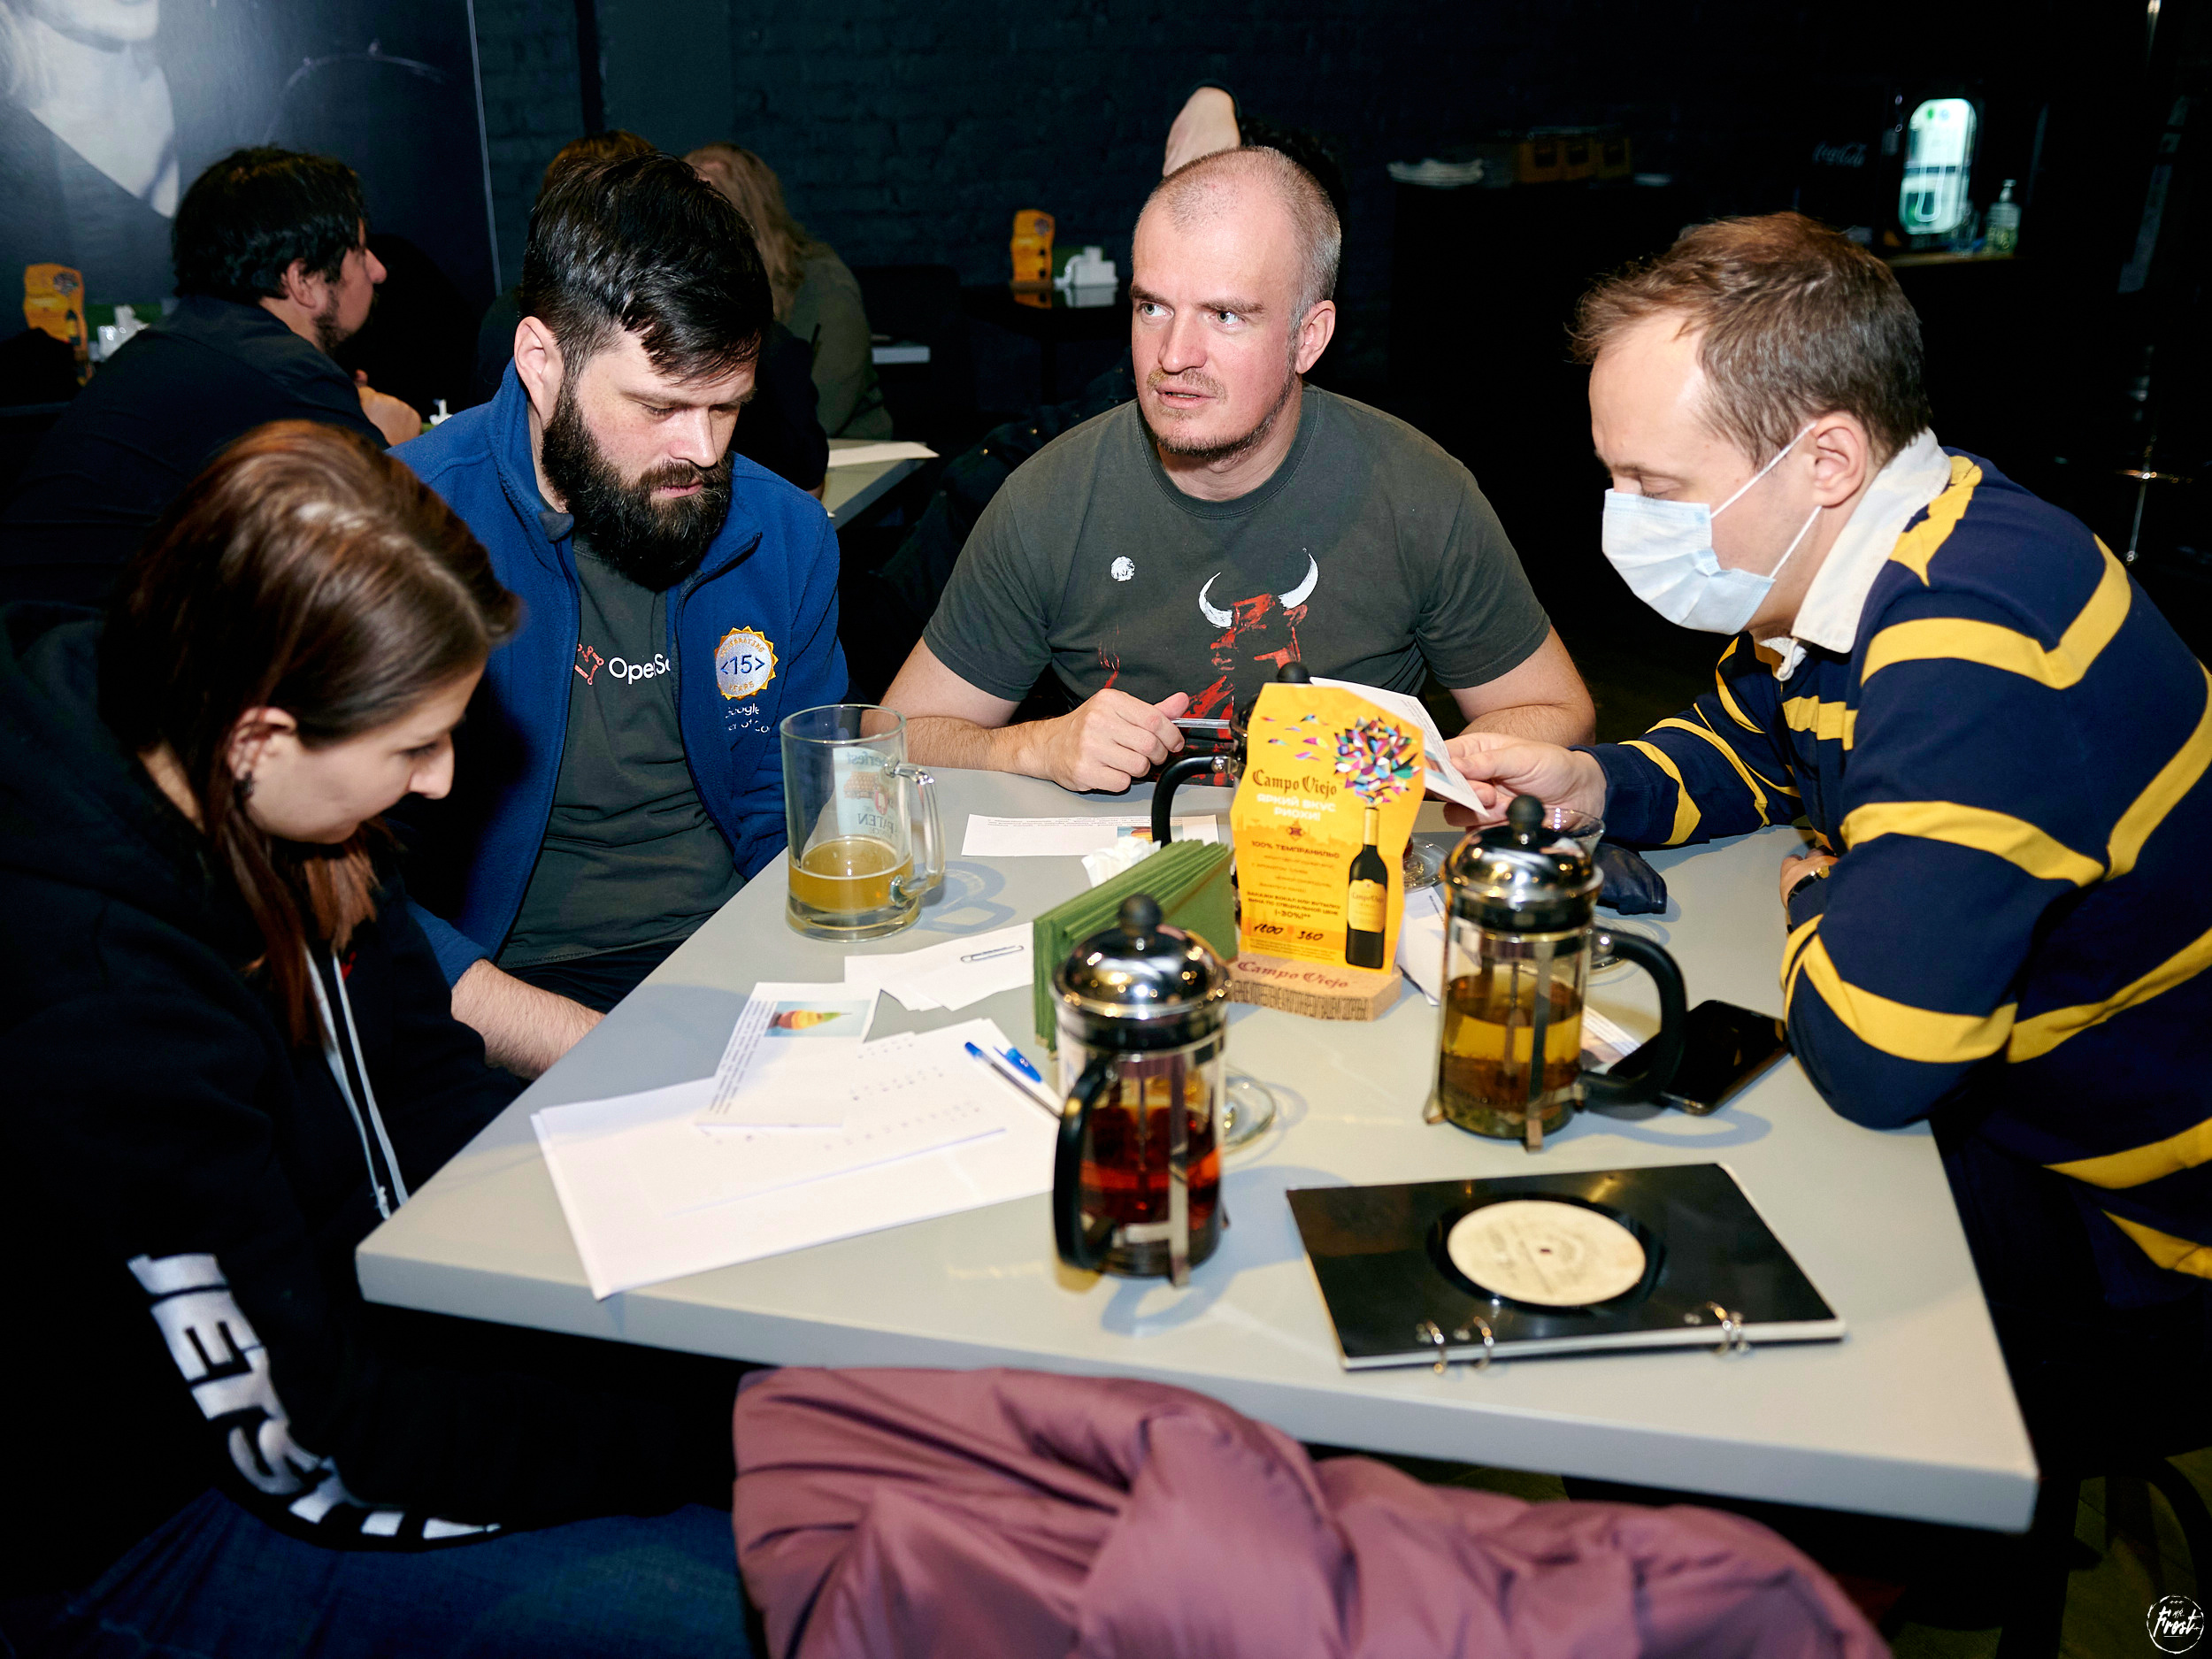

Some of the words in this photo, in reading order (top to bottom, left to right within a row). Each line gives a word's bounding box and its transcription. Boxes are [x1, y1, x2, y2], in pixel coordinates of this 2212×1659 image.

[728, 680, 755, 692] YEARS
[1252, 769, 1299, 794] Campo
[1302, 775, 1337, 800] Viejo
[1256, 794, 1299, 807] ЯРКИЙ
[1302, 799, 1336, 812] ВКУС
[1274, 806, 1321, 821] РИОХИ!
[1252, 841, 1273, 849] 100%
[1296, 931, 1324, 941] 360
[1237, 961, 1299, 980] Campo
[1302, 972, 1348, 989] Viejo
